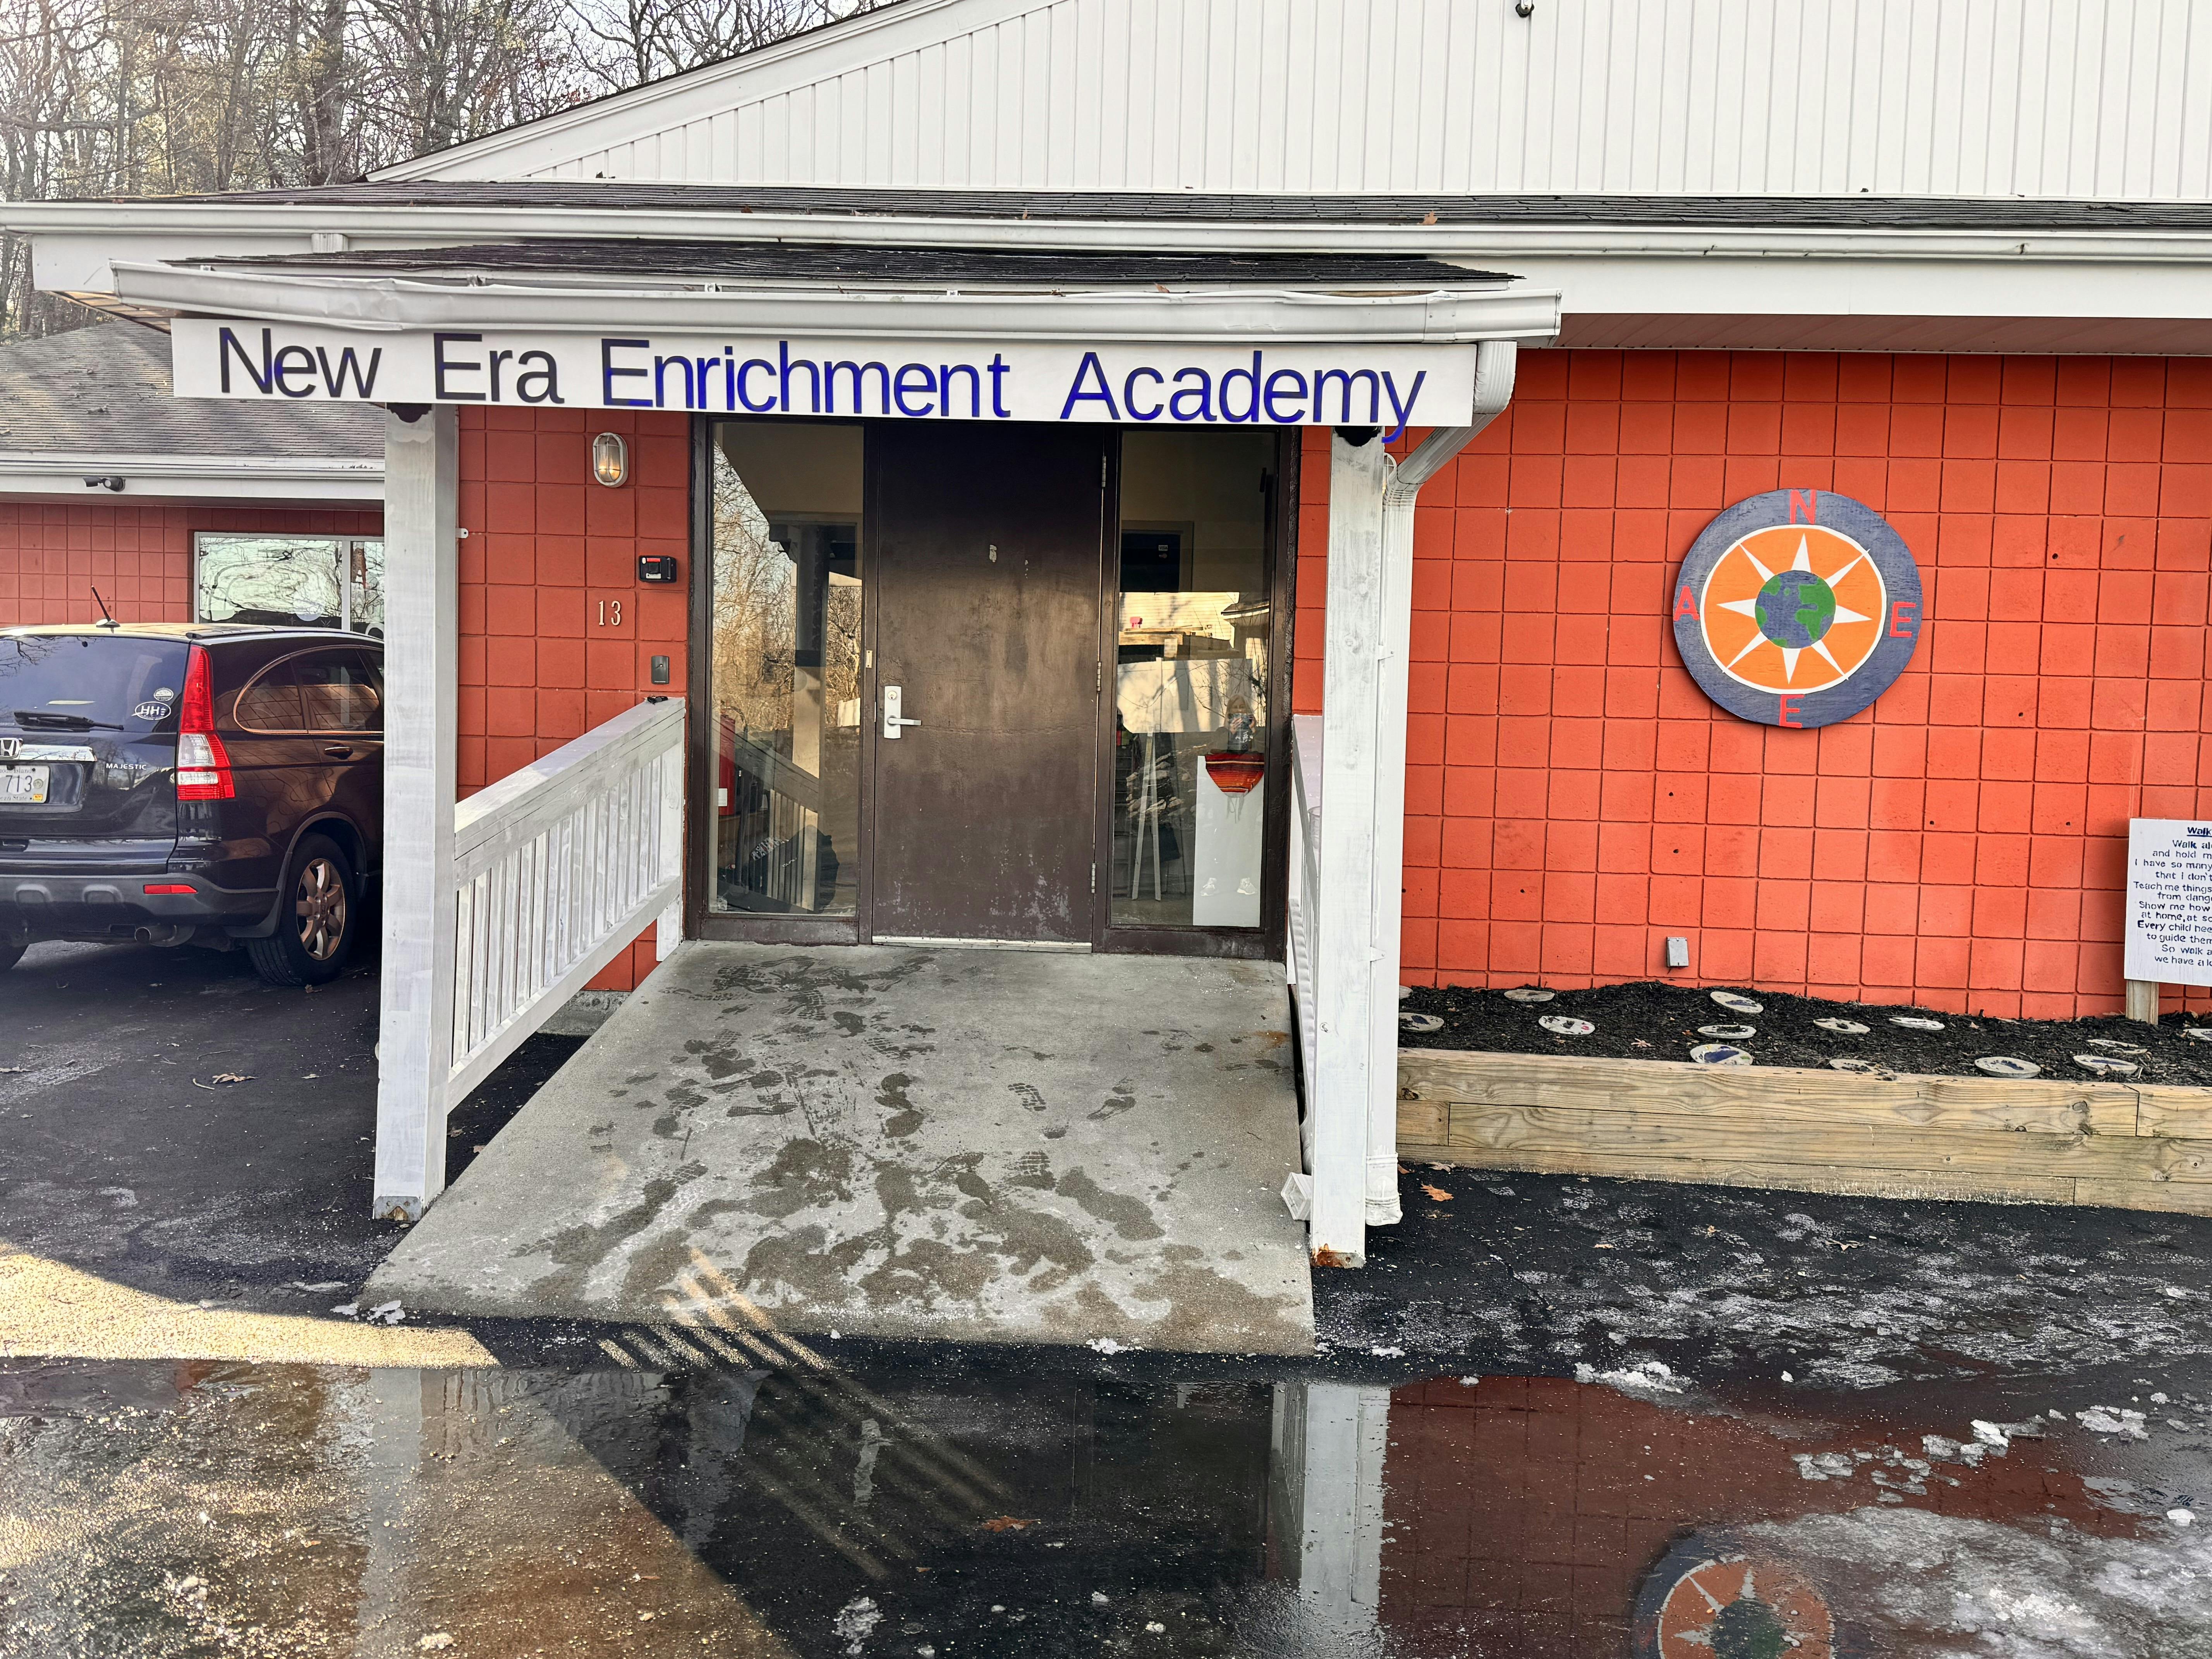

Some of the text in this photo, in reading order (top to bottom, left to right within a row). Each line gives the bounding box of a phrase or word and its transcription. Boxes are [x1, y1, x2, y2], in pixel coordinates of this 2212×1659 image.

[219, 327, 1427, 443] New Era Enrichment Academy
[1790, 489, 1817, 524] N
[1673, 585, 1700, 621] A
[599, 600, 621, 626] 13
[1889, 601, 1917, 637] E
[1779, 694, 1805, 728] E
[5, 775, 32, 792] 713
[2187, 827, 2212, 835] Walk
[2172, 840, 2197, 849] Walk
[2143, 859, 2166, 867] have
[2186, 862, 2212, 871] many
[2188, 872, 2212, 881] don't
[2133, 881, 2162, 890] Teach
[2182, 884, 2212, 894] things
[2157, 891, 2212, 904] from dang
[2139, 901, 2166, 910] Show
[2189, 903, 2210, 912] how
[2137, 920, 2212, 933] Every child nee
[2159, 934, 2186, 943] guide
[2162, 944, 2175, 953] So
[2172, 956, 2194, 965] have
